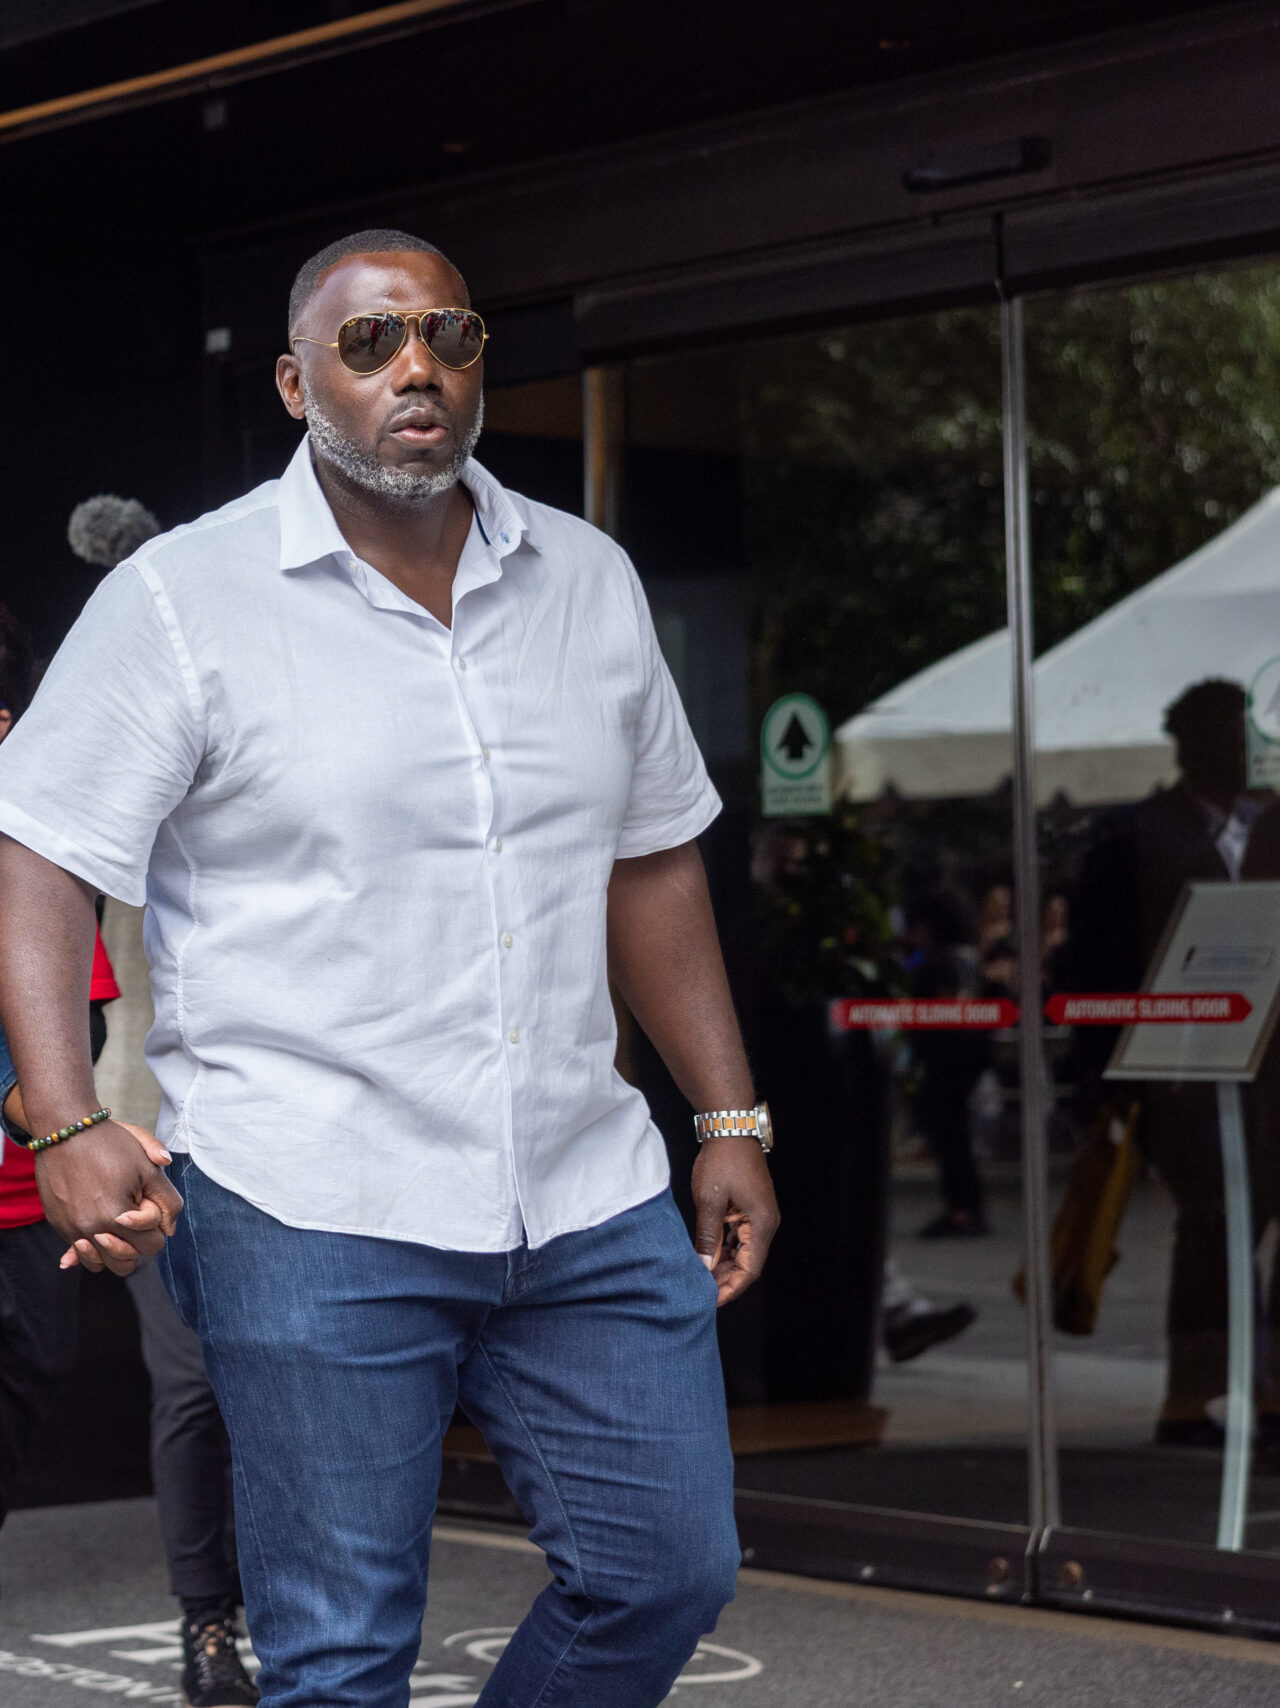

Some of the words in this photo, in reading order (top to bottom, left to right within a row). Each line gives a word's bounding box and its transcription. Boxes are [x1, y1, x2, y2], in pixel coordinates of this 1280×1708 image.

[1064, 998, 1136, 1019] AUTOMATIC
[1138, 998, 1190, 1018] SLIDING
[1192, 998, 1231, 1018] DOOR
